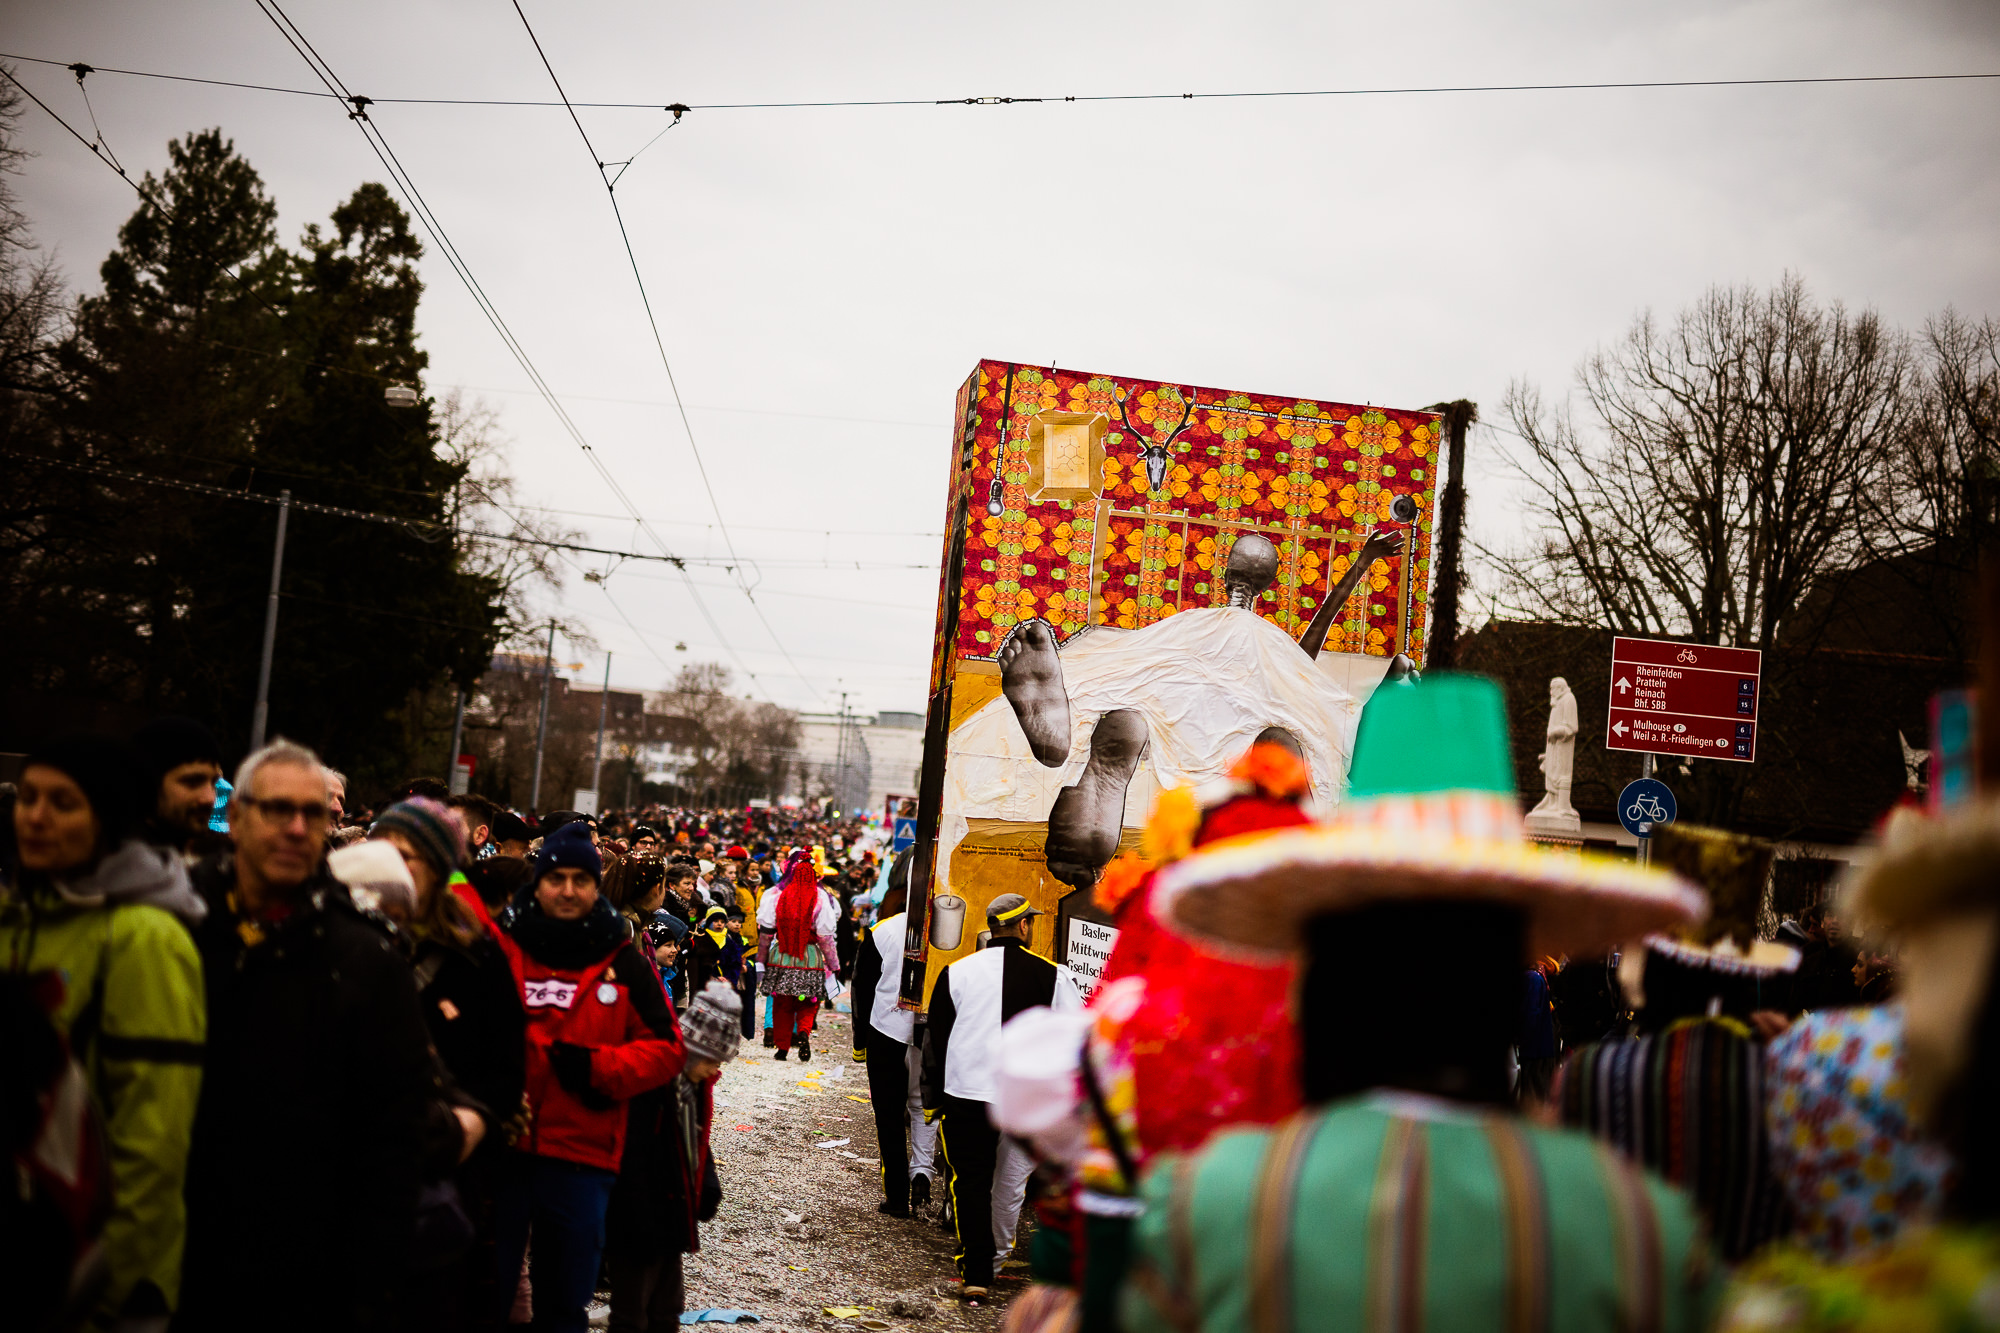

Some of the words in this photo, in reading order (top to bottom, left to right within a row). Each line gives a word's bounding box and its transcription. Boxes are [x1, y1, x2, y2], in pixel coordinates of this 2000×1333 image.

[1636, 666, 1682, 679] Rheinfelden
[1636, 676, 1667, 688] Pratteln
[1636, 688, 1666, 698] Reinach
[1634, 698, 1648, 708] Bhf.
[1652, 700, 1666, 710] SBB
[1634, 720, 1670, 732] Mulhouse
[1633, 730, 1650, 740] Weil
[1661, 733, 1713, 748] R.-Friedlingen
[1082, 924, 1111, 941] Basler
